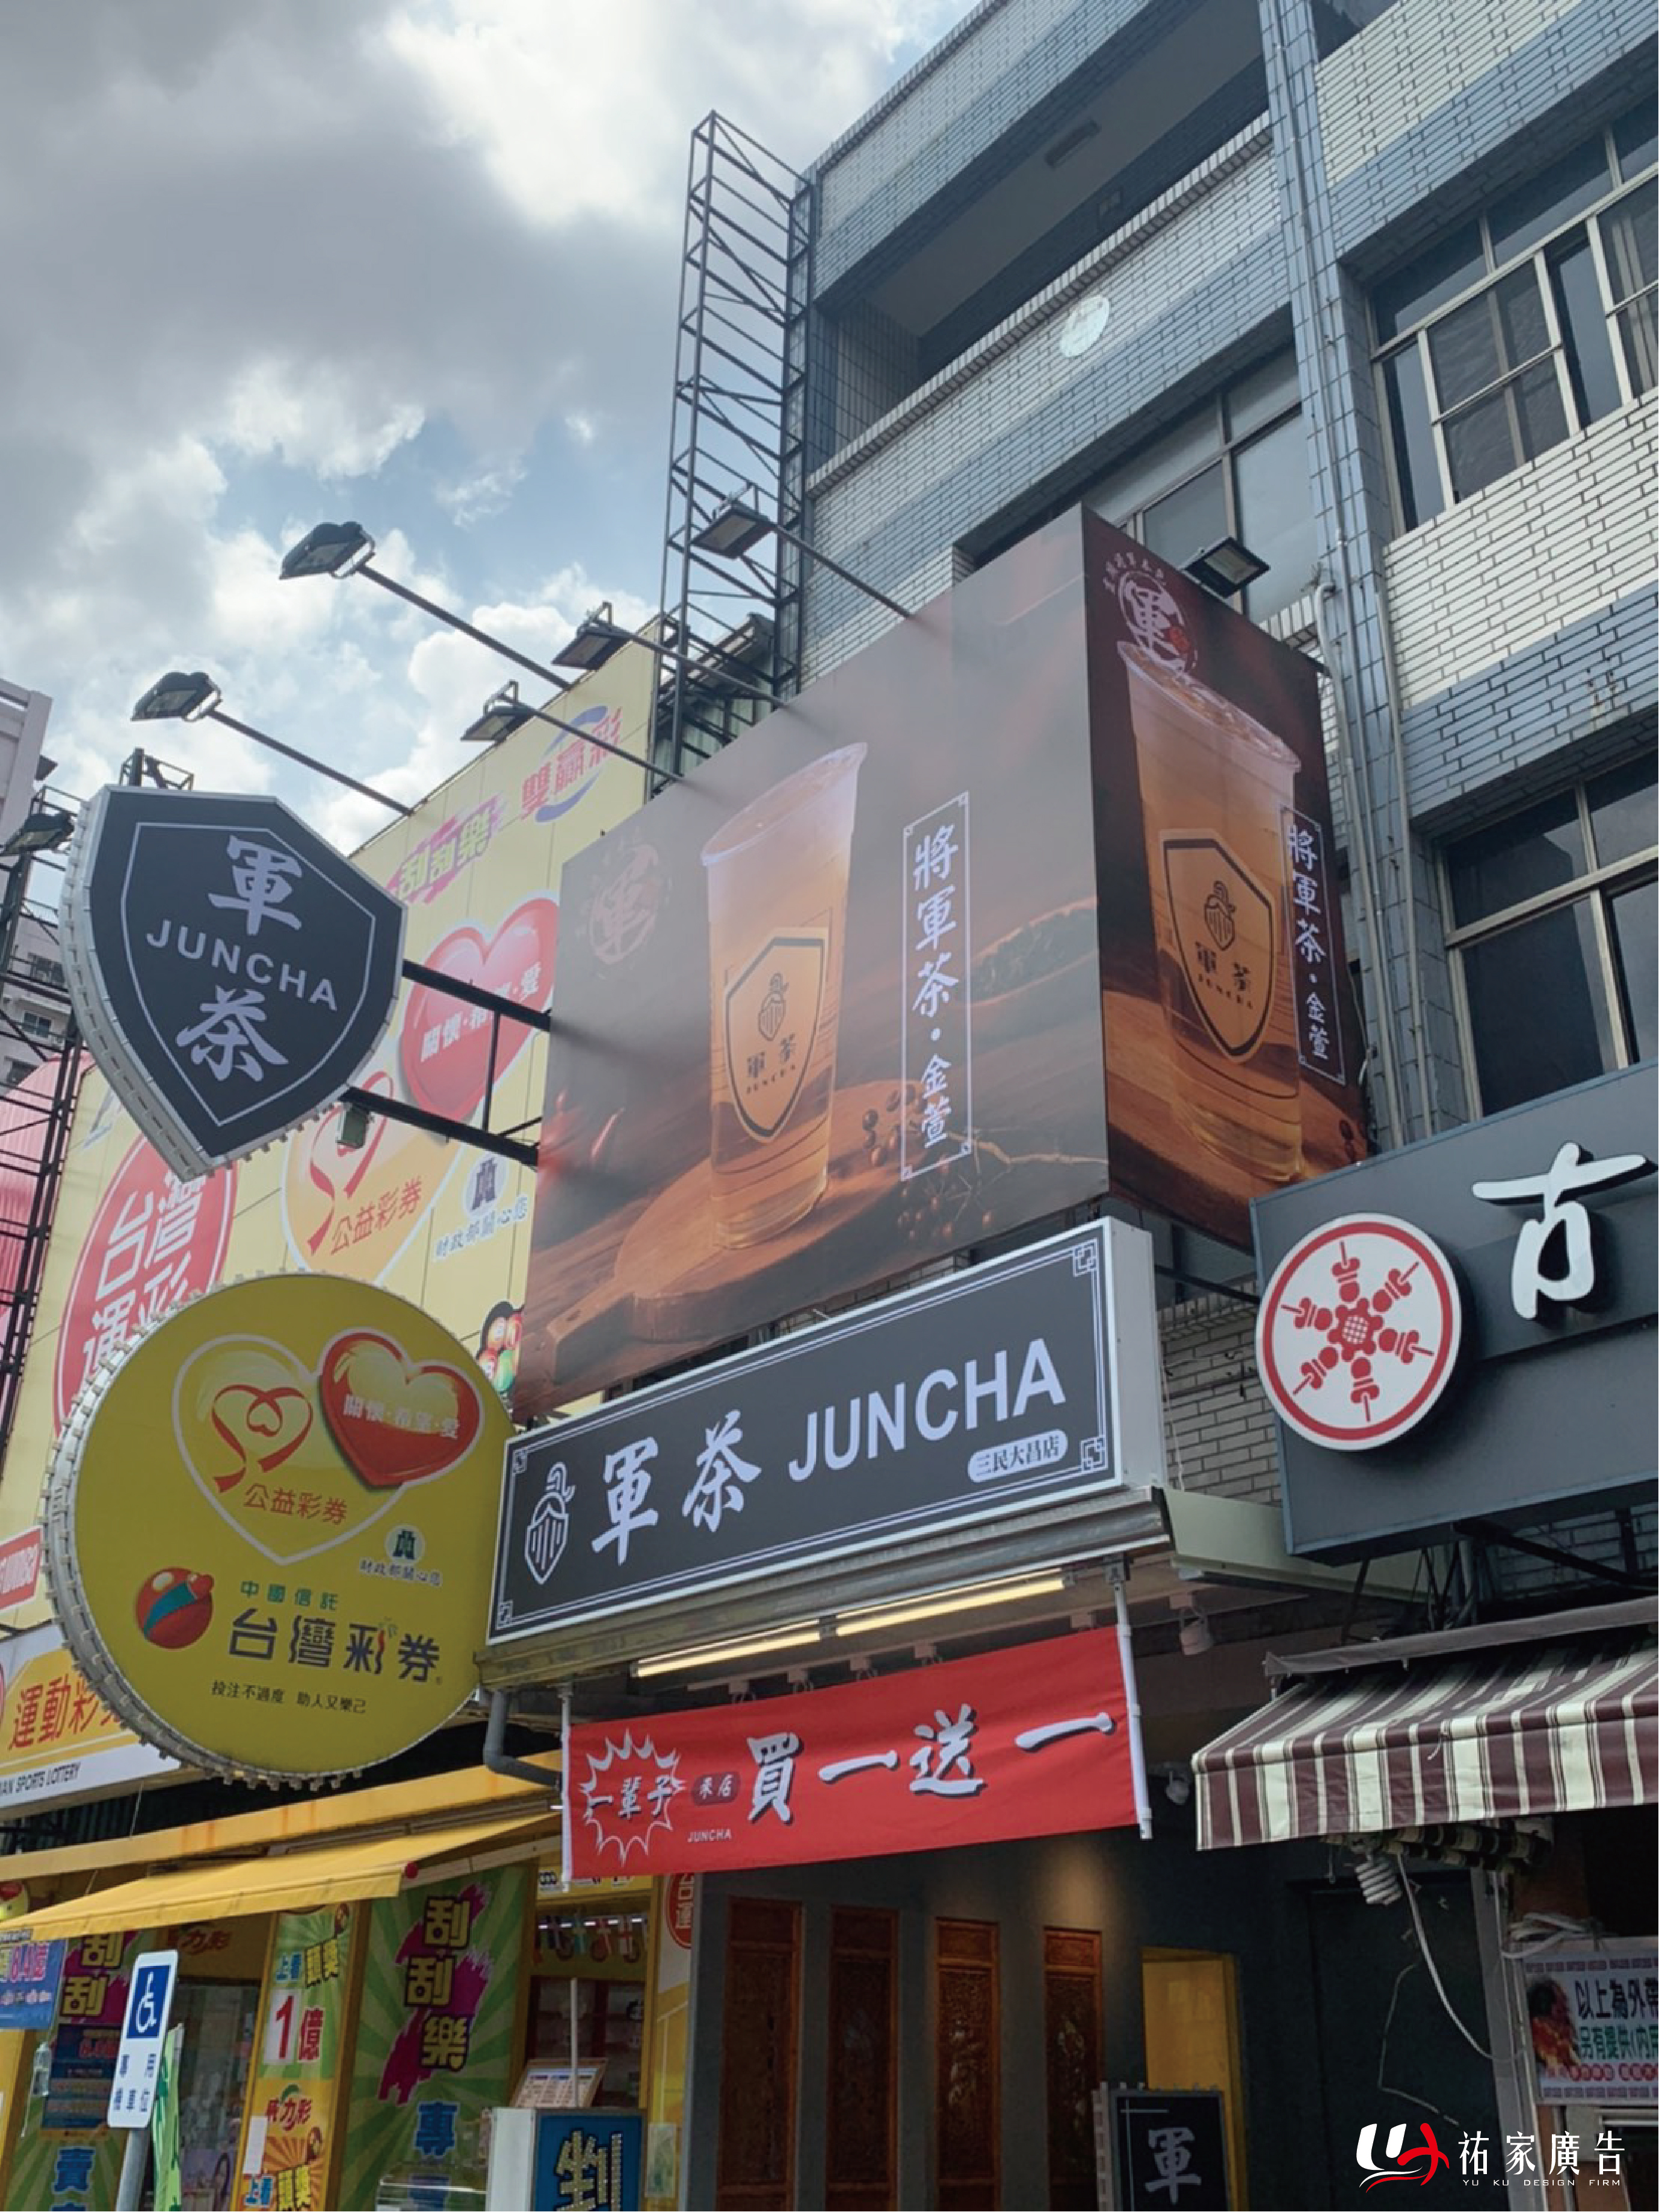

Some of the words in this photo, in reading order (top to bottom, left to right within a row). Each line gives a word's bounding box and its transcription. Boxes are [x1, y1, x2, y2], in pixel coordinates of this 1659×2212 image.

[208, 834, 303, 935] 軍
[399, 803, 492, 901] 刮刮樂
[146, 919, 338, 1012] JUNCHA
[175, 984, 289, 1082] 茶
[330, 1175, 422, 1255] 公益彩券
[1471, 1141, 1647, 1320] 古
[591, 1408, 762, 1567] 軍茶
[787, 1338, 1066, 1483] JUNCHA
[975, 1434, 1061, 1477] 三民大昌店
[243, 1482, 348, 1526] 公益彩券
[241, 1580, 339, 1611] 中國信託
[229, 1607, 440, 1683] 台灣彩券
[15, 1770, 46, 1793] SPORTS
[46, 1761, 81, 1785] LOTTERY
[588, 1775, 674, 1820] 一輩子
[747, 1703, 1114, 1825] 買一送一
[687, 1828, 732, 1843] JUNCHA
[404, 1896, 471, 2072] 刮刮樂
[276, 1995, 294, 2060] 1
[1145, 2126, 1202, 2205] 軍
